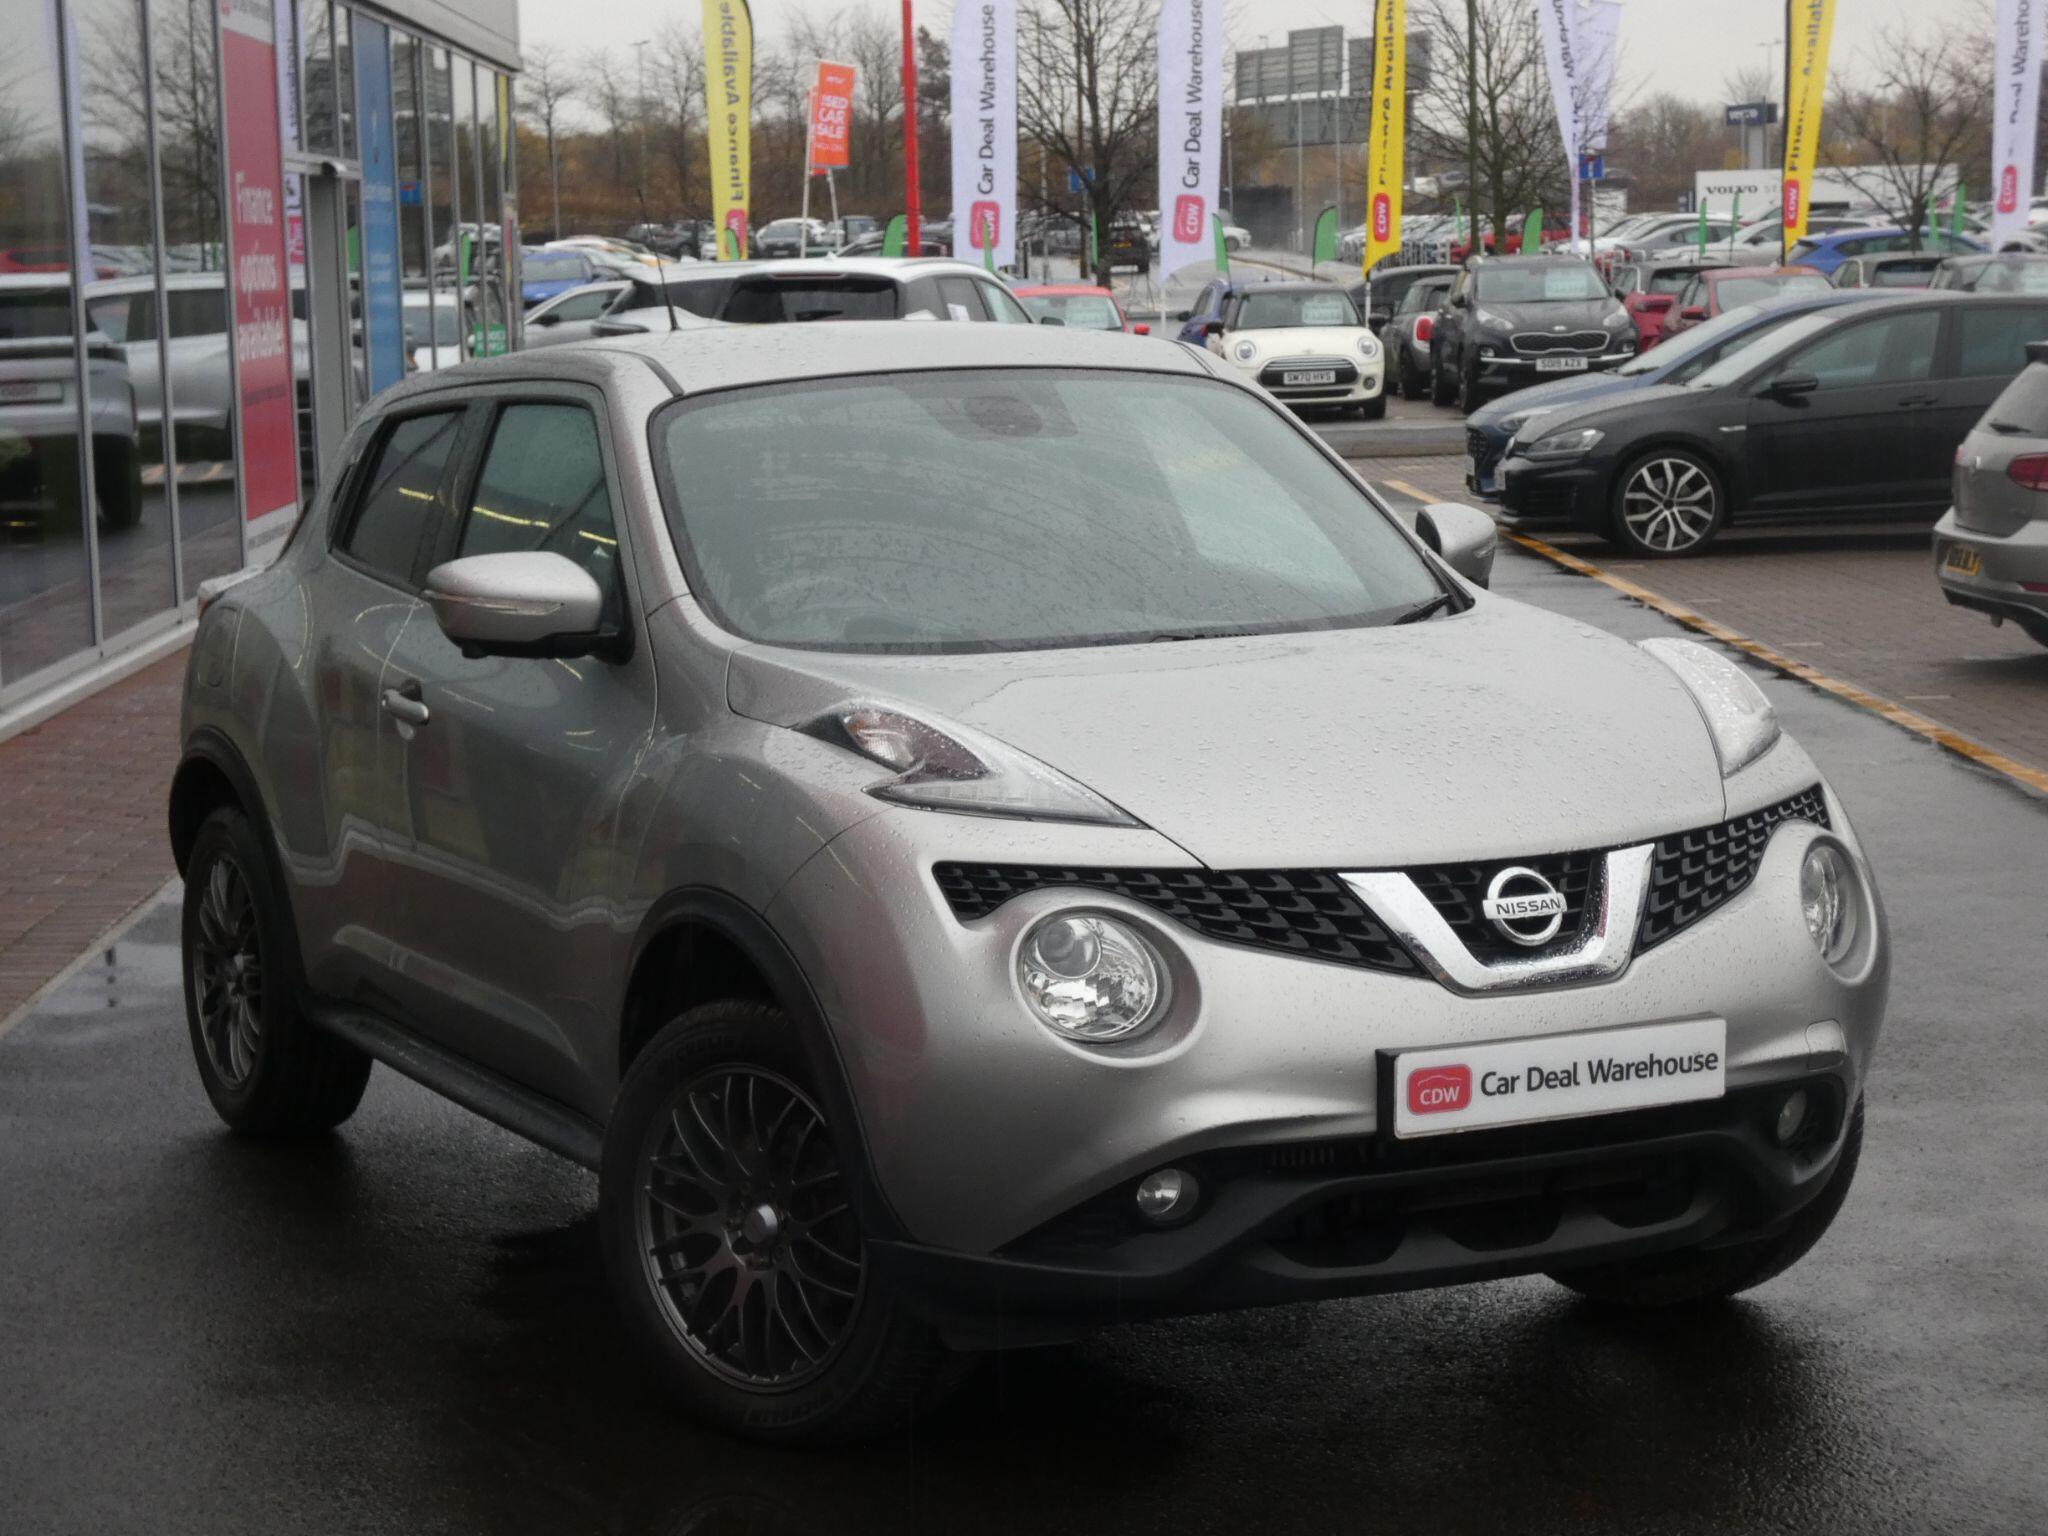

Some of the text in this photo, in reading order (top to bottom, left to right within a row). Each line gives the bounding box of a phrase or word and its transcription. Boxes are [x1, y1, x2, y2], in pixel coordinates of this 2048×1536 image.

[979, 4, 995, 111] Warehouse
[815, 122, 845, 139] SALE
[818, 107, 846, 125] CAR
[1182, 0, 1203, 235] CDW Car Deal Warehouse
[979, 117, 995, 159] Deal
[977, 164, 994, 194] Car
[1706, 184, 1758, 195] VOLVO
[1375, 202, 1387, 234] CDW
[1787, 187, 1799, 221] CDW
[1496, 899, 1561, 915] NISSAN
[1419, 1053, 1719, 1105] CDW Car Deal Warehouse
